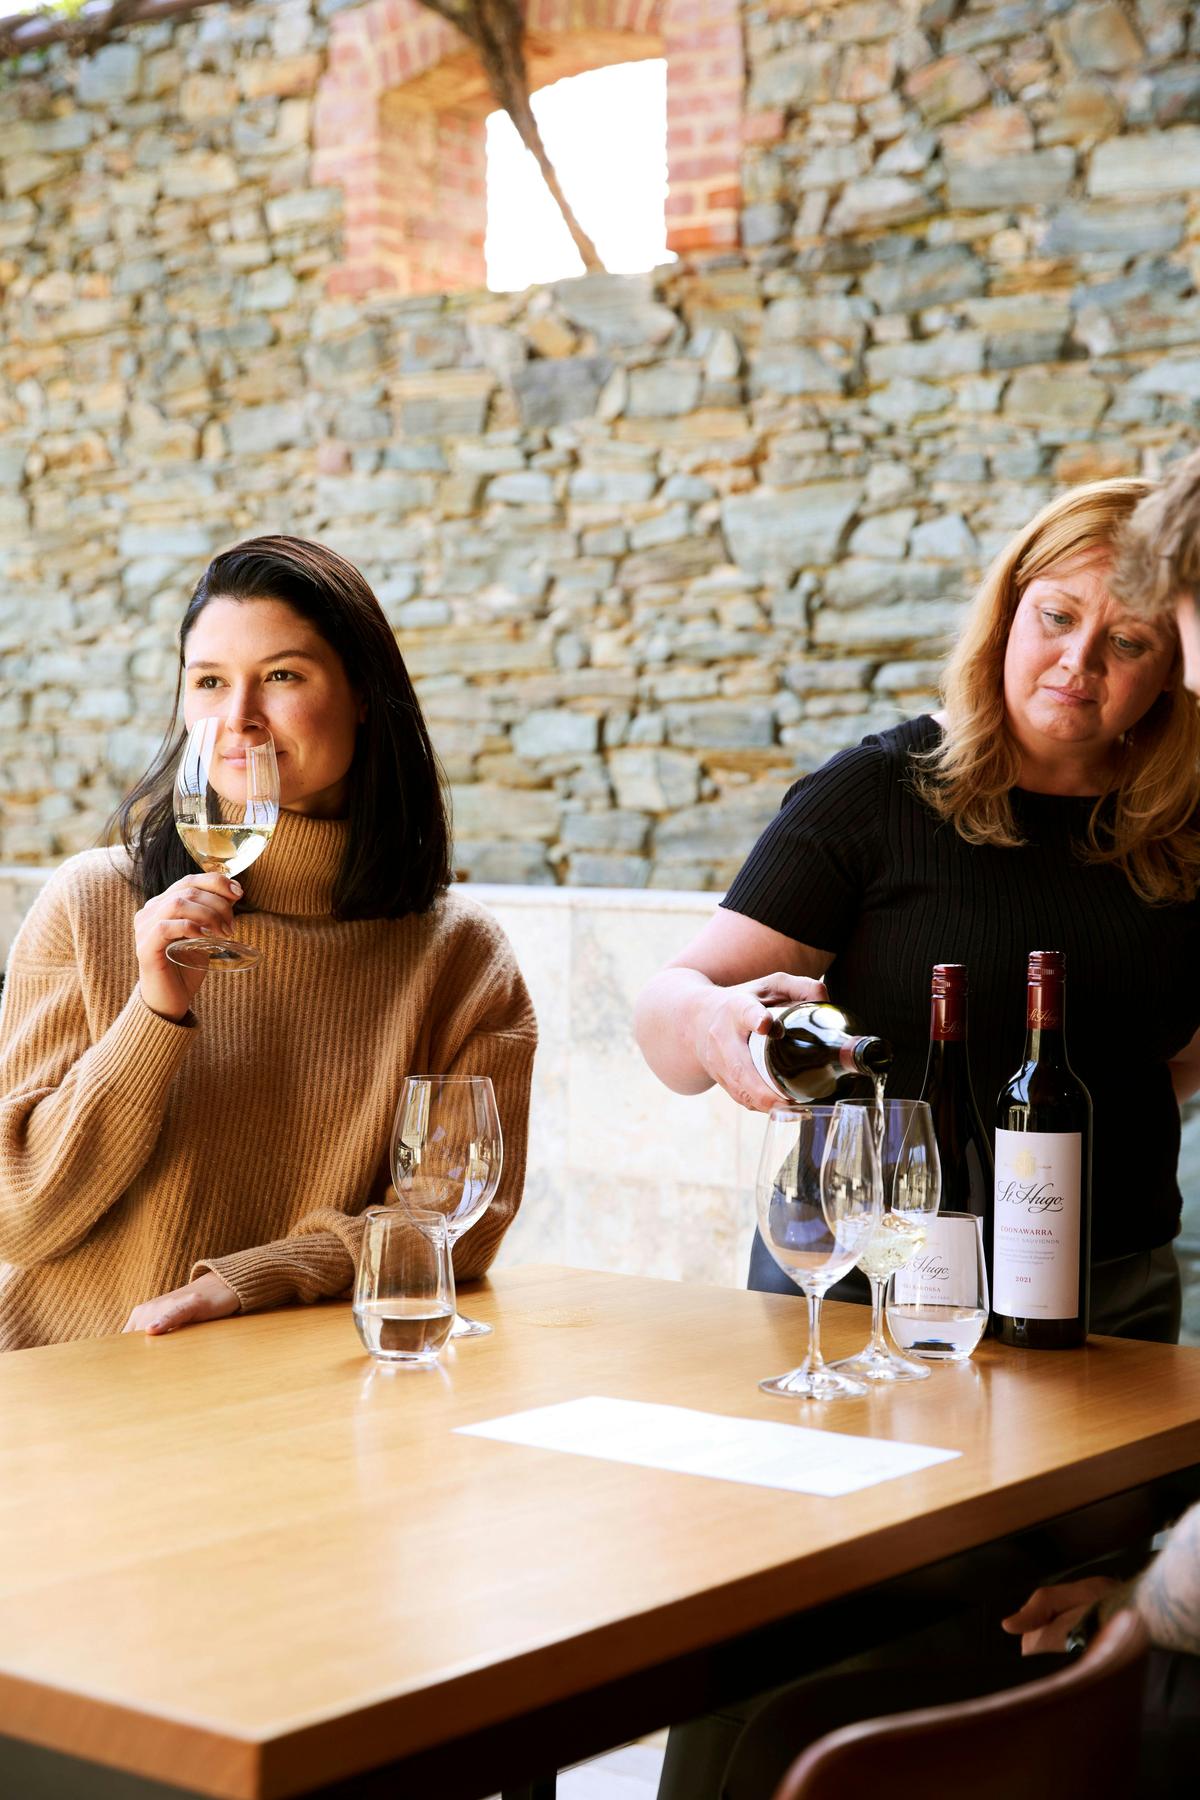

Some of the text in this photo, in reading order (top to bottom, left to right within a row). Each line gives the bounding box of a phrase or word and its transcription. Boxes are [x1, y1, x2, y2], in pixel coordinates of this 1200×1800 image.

[997, 1180, 1016, 1202] St
[1000, 1225, 1053, 1236] COONAWARRA
[1015, 1276, 1032, 1284] 2021
